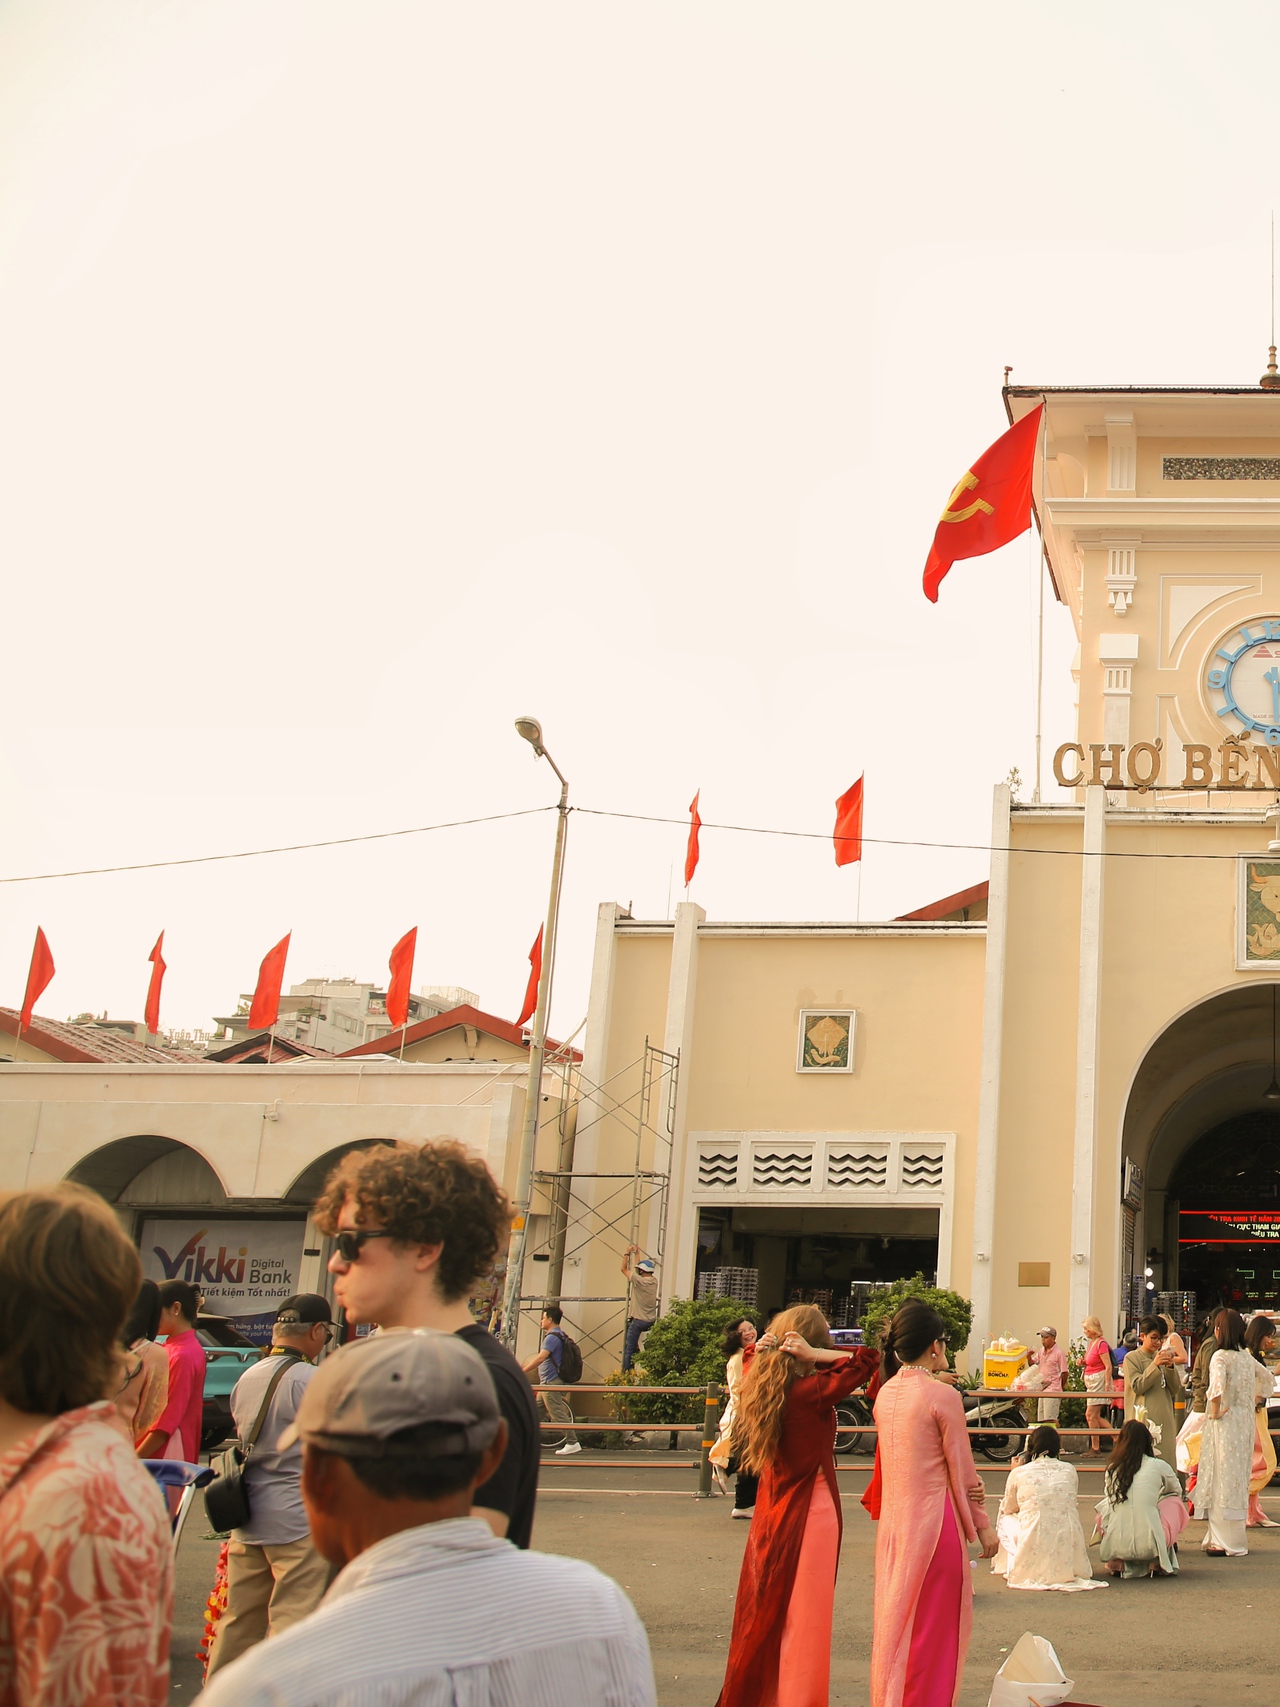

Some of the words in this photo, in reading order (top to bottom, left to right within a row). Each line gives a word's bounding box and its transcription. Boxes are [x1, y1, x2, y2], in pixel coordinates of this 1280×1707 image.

[1207, 669, 1227, 689] 9
[1053, 738, 1164, 795] CHỢ
[153, 1228, 248, 1283] Vikki
[251, 1259, 285, 1271] Digital
[249, 1269, 292, 1284] Bank
[200, 1287, 220, 1296] Tiết
[221, 1288, 245, 1299] kiệm
[247, 1286, 263, 1297] Tốt
[264, 1287, 291, 1297] nhất!
